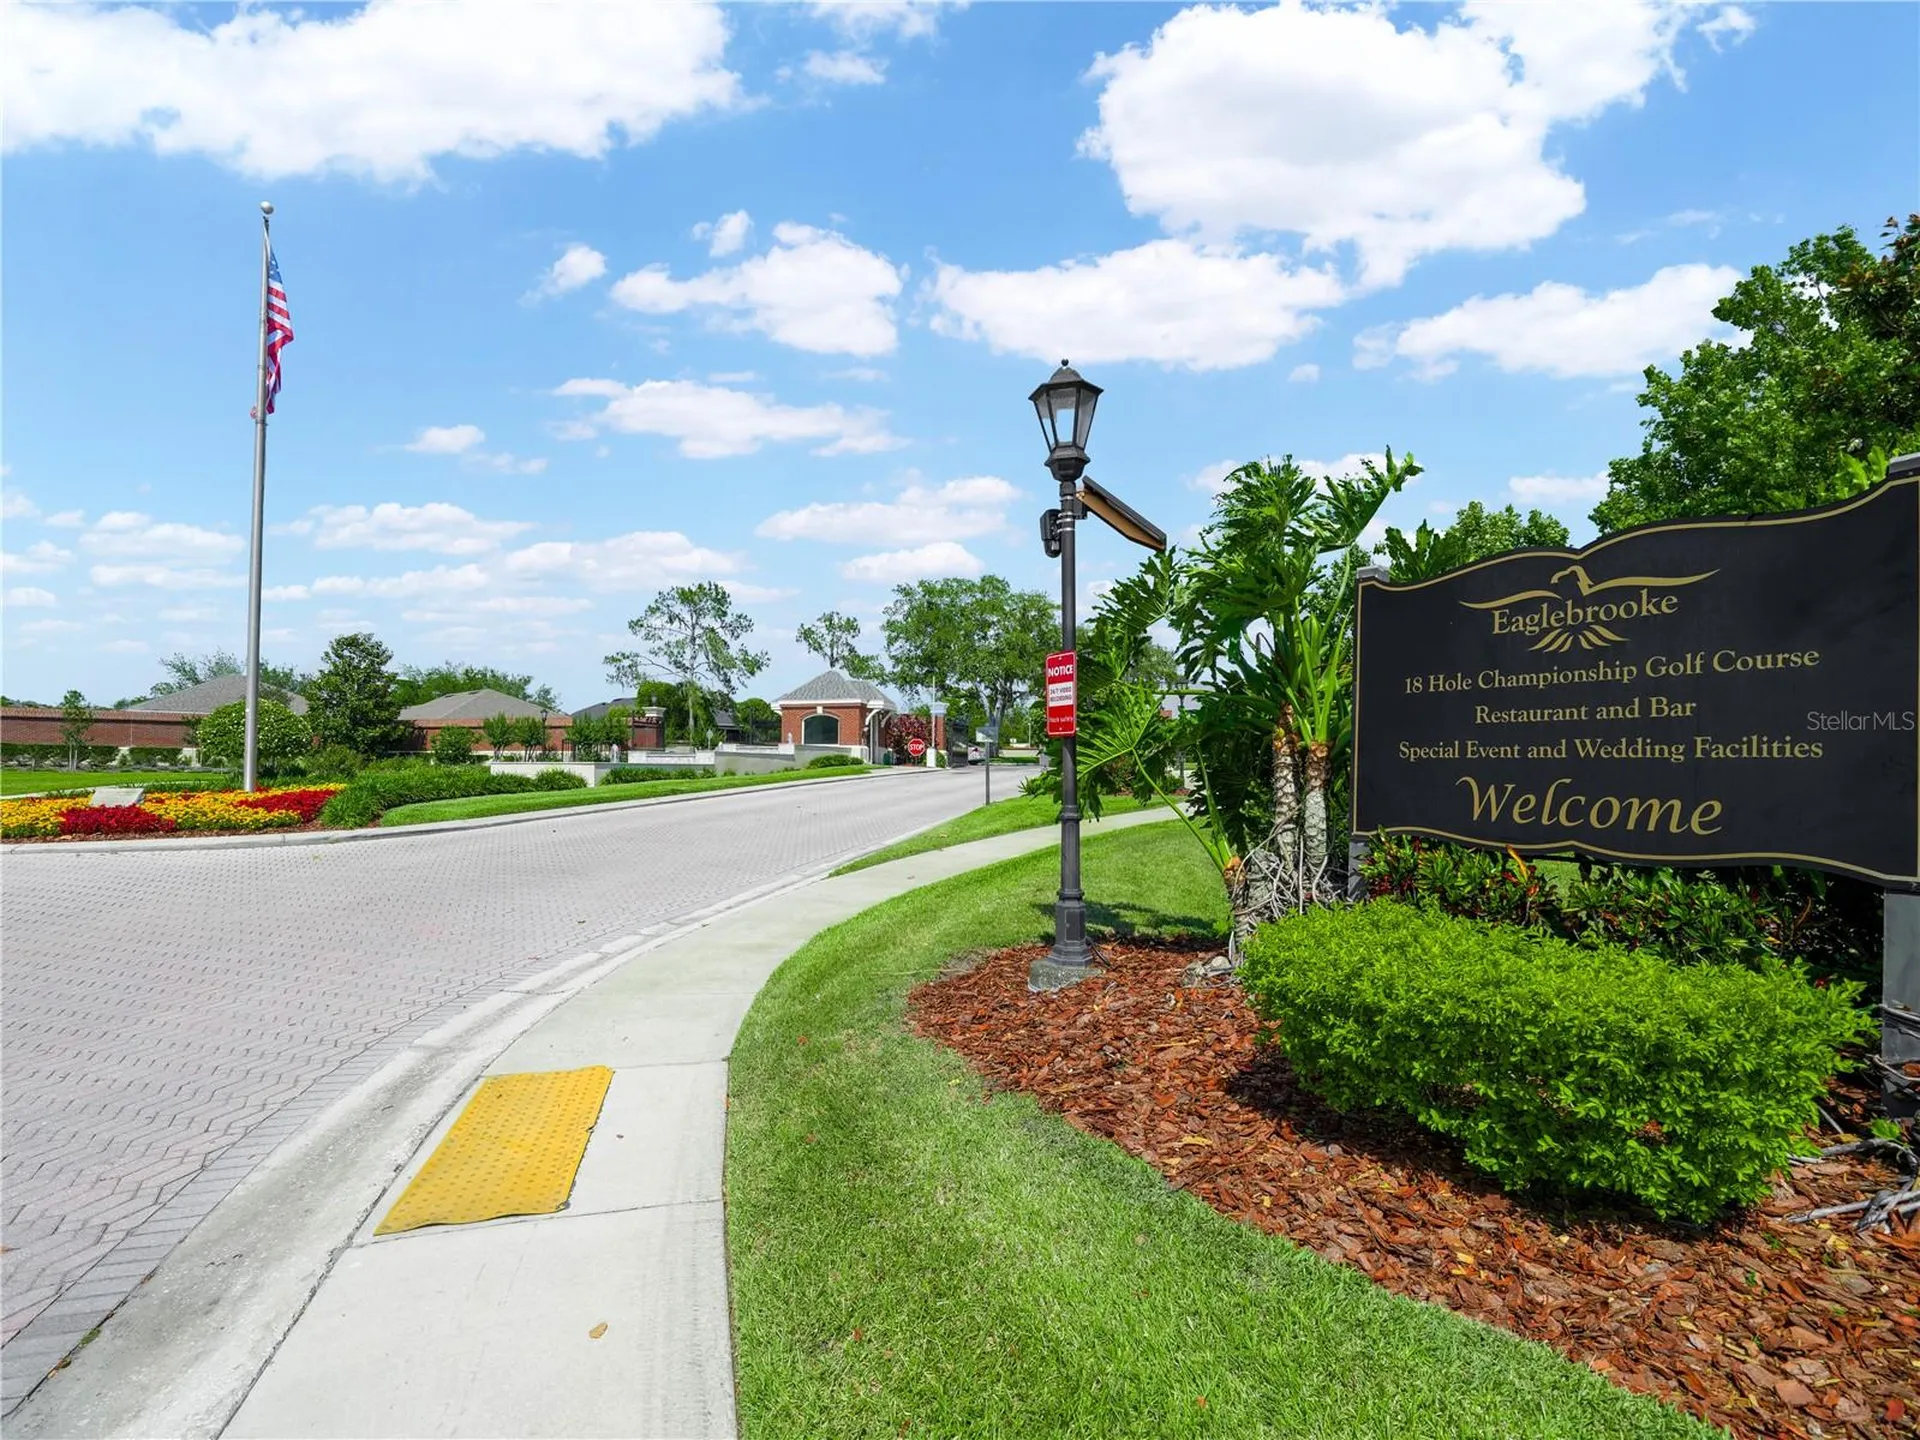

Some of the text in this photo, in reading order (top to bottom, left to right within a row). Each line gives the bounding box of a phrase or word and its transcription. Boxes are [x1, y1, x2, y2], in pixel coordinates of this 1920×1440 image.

[1491, 588, 1679, 635] Eaglebrooke
[1047, 664, 1073, 677] NOTICE
[1404, 648, 1820, 694] 18 Hole Championship Golf Course
[1475, 696, 1697, 724] Restaurant and Bar
[909, 743, 924, 751] STOP
[1399, 735, 1824, 764] Special Event and Wedding Facilities
[1455, 776, 1724, 836] Welcome
